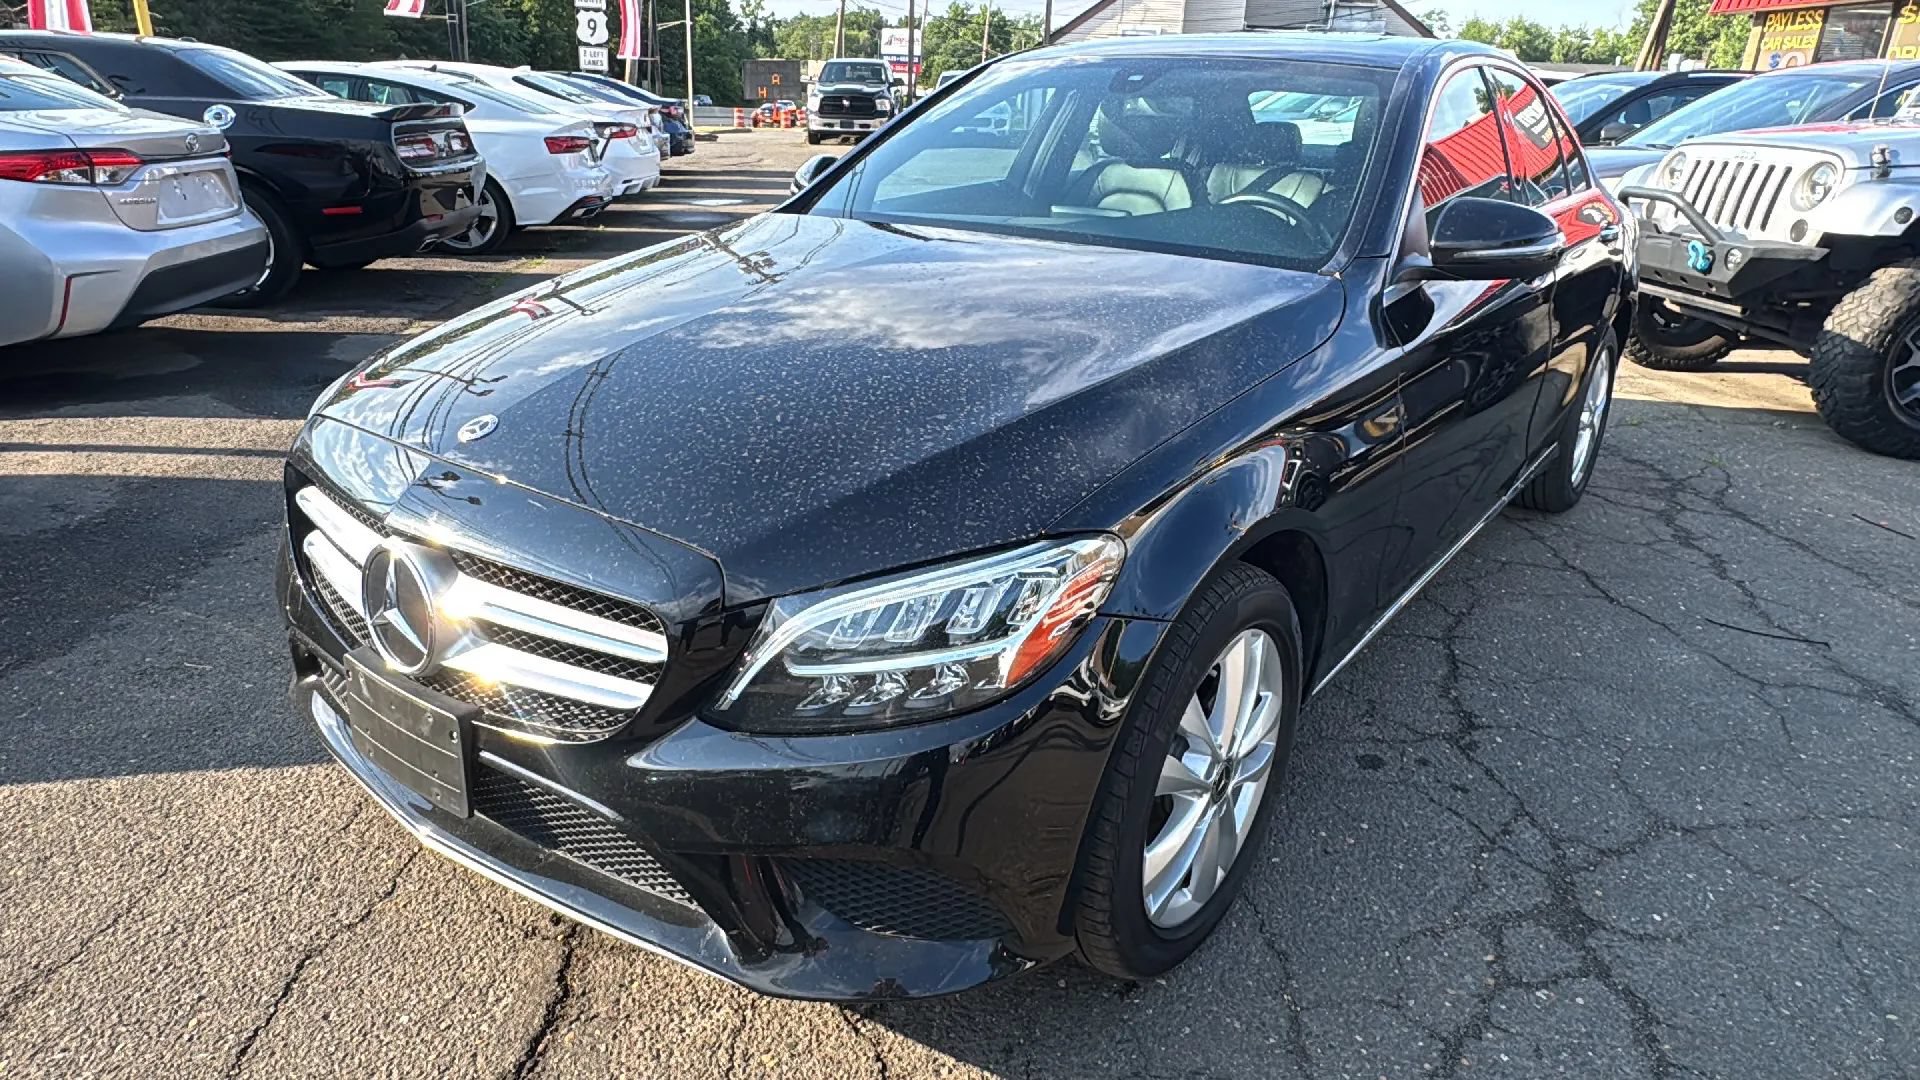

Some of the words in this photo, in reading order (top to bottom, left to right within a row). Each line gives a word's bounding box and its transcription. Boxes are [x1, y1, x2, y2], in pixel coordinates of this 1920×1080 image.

[1763, 9, 1825, 32] PAYLESS
[588, 18, 597, 37] 9
[1760, 37, 1783, 50] CAR
[1781, 35, 1818, 50] SALES
[589, 50, 604, 58] LEFT
[583, 59, 604, 67] LANES
[771, 73, 781, 85] A
[758, 86, 768, 99] H
